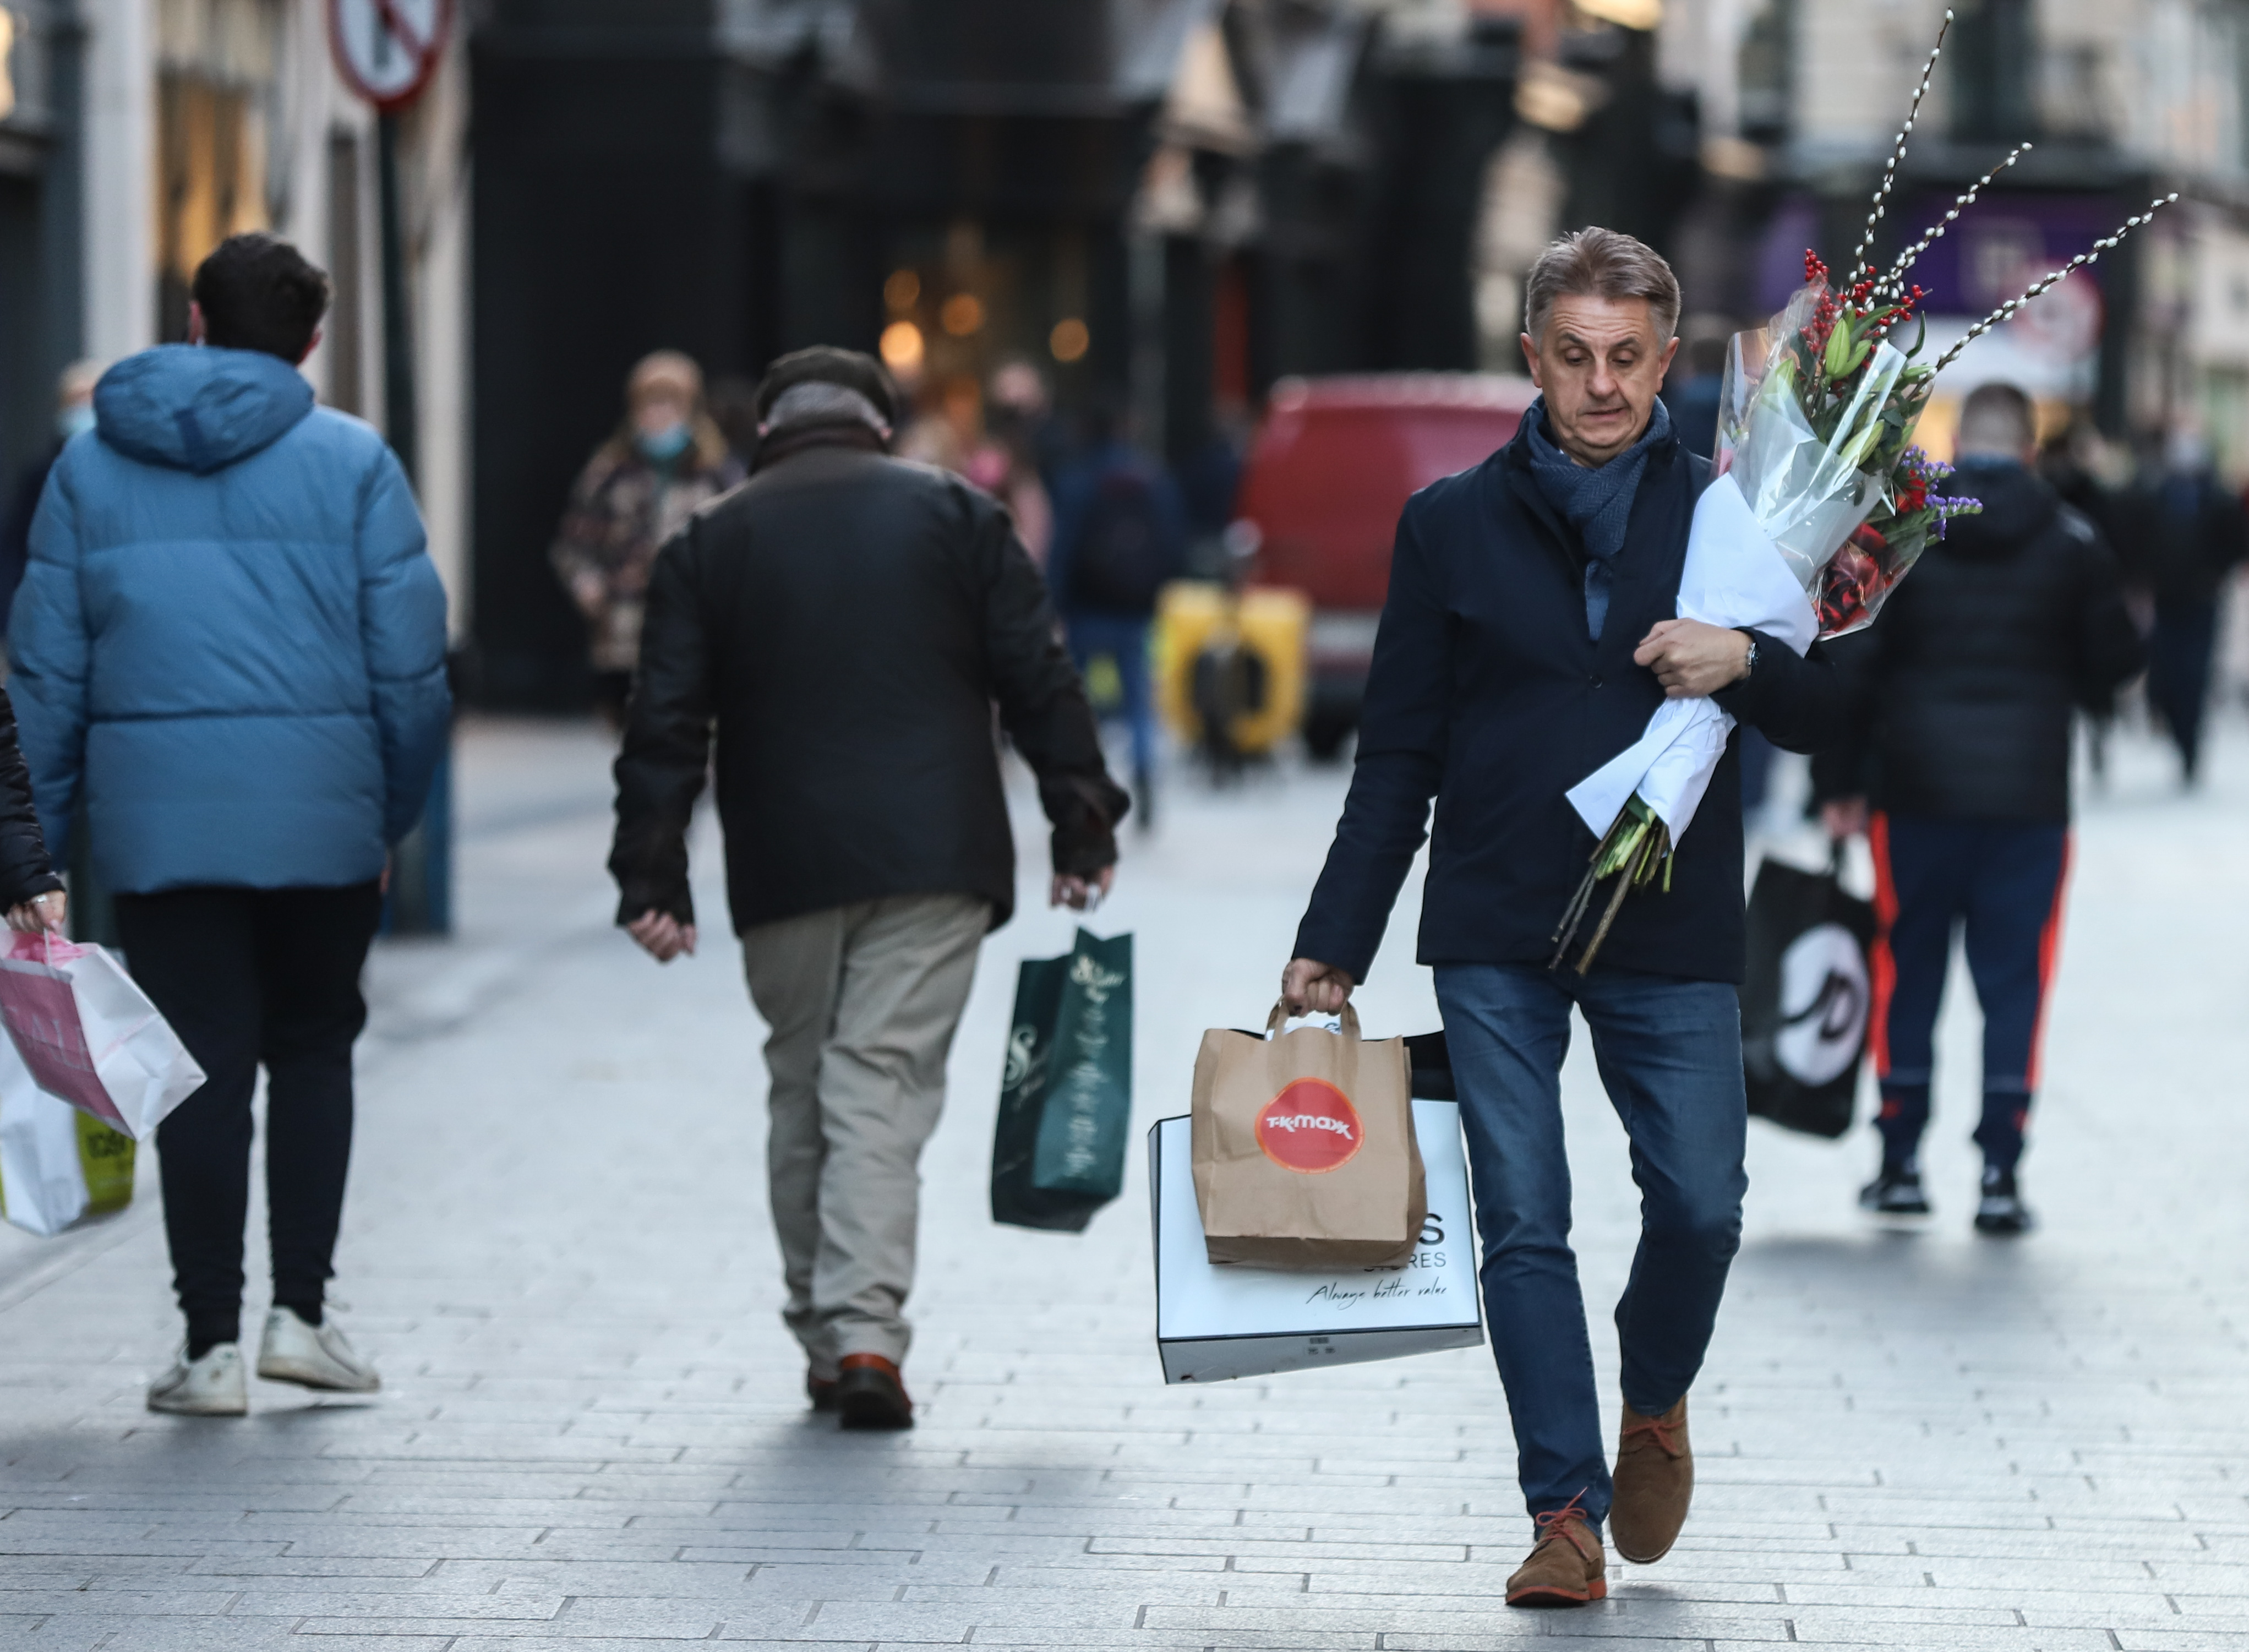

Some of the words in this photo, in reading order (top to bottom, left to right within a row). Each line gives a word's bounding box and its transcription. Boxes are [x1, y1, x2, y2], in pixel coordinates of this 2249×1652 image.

[1306, 1282, 1365, 1310] Always
[1373, 1278, 1410, 1299] better
[1418, 1277, 1447, 1296] value
